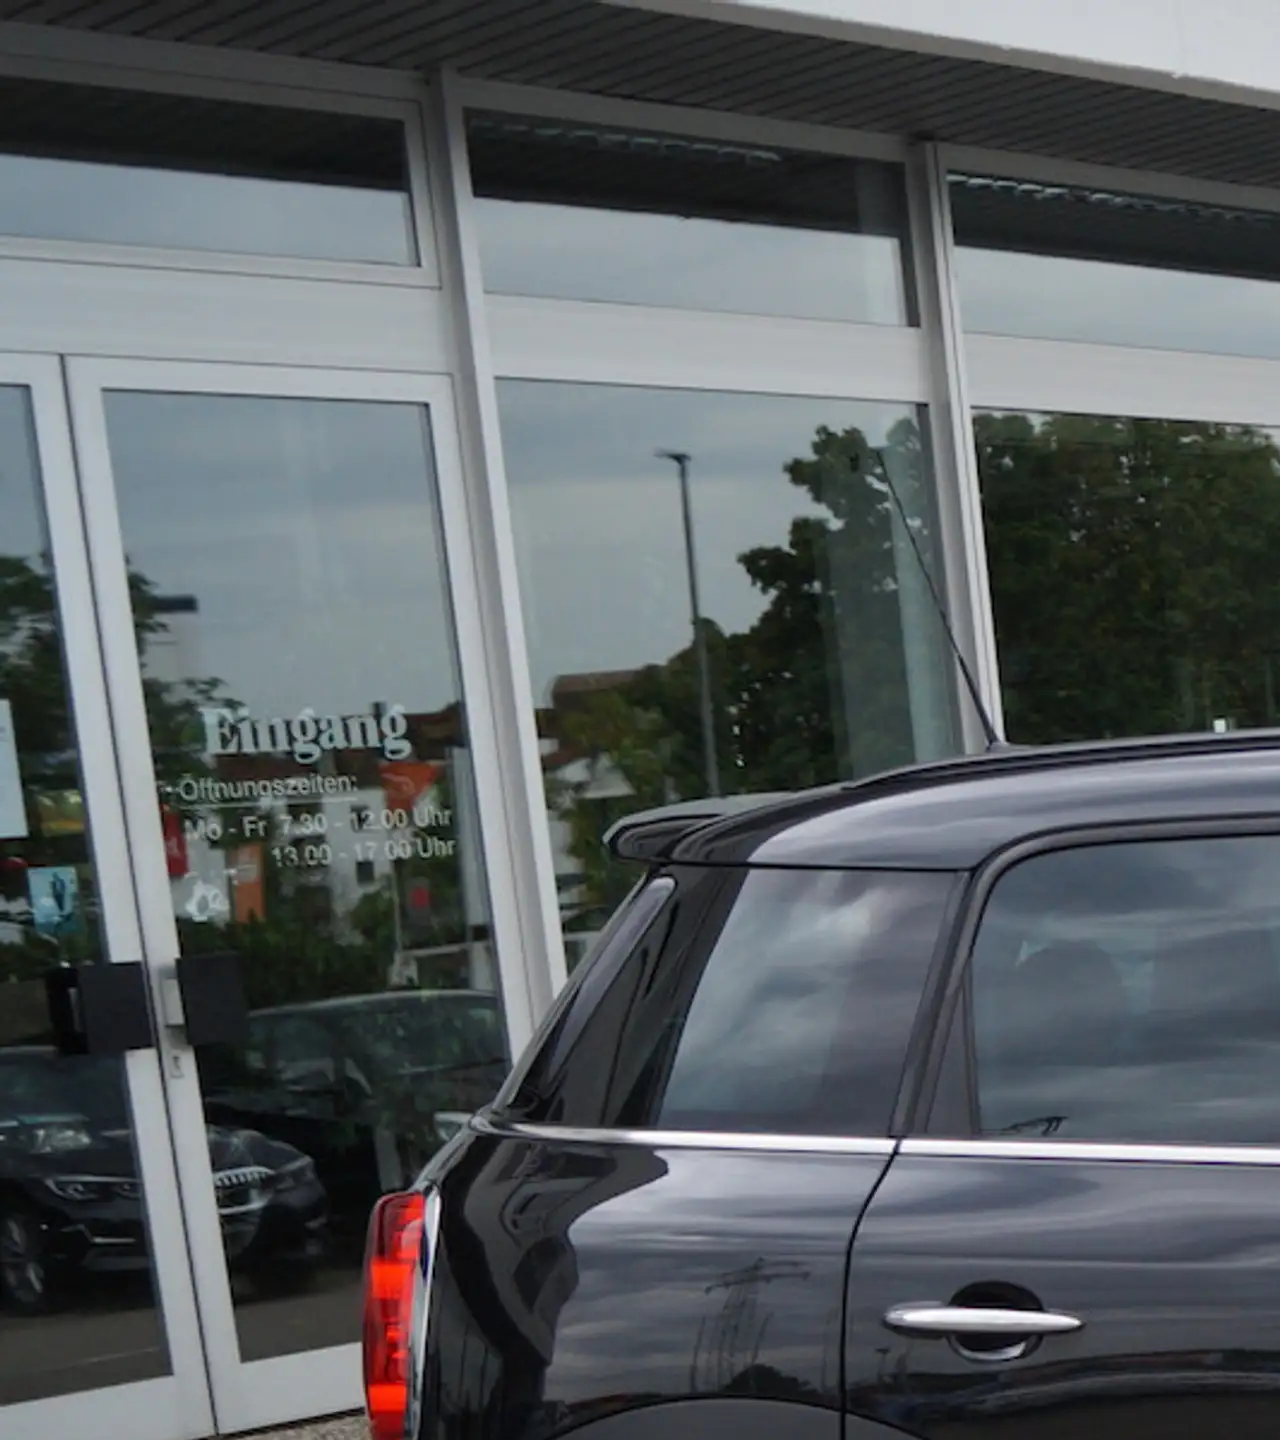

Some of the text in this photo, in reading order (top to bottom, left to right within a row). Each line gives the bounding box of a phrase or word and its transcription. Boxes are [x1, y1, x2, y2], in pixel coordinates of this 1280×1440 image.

[200, 706, 412, 762] Eingang
[184, 819, 222, 840] Mo
[242, 816, 268, 837] Fr
[279, 813, 328, 835] 7.30
[412, 806, 453, 828] Uhr
[414, 836, 456, 859] Uhr
